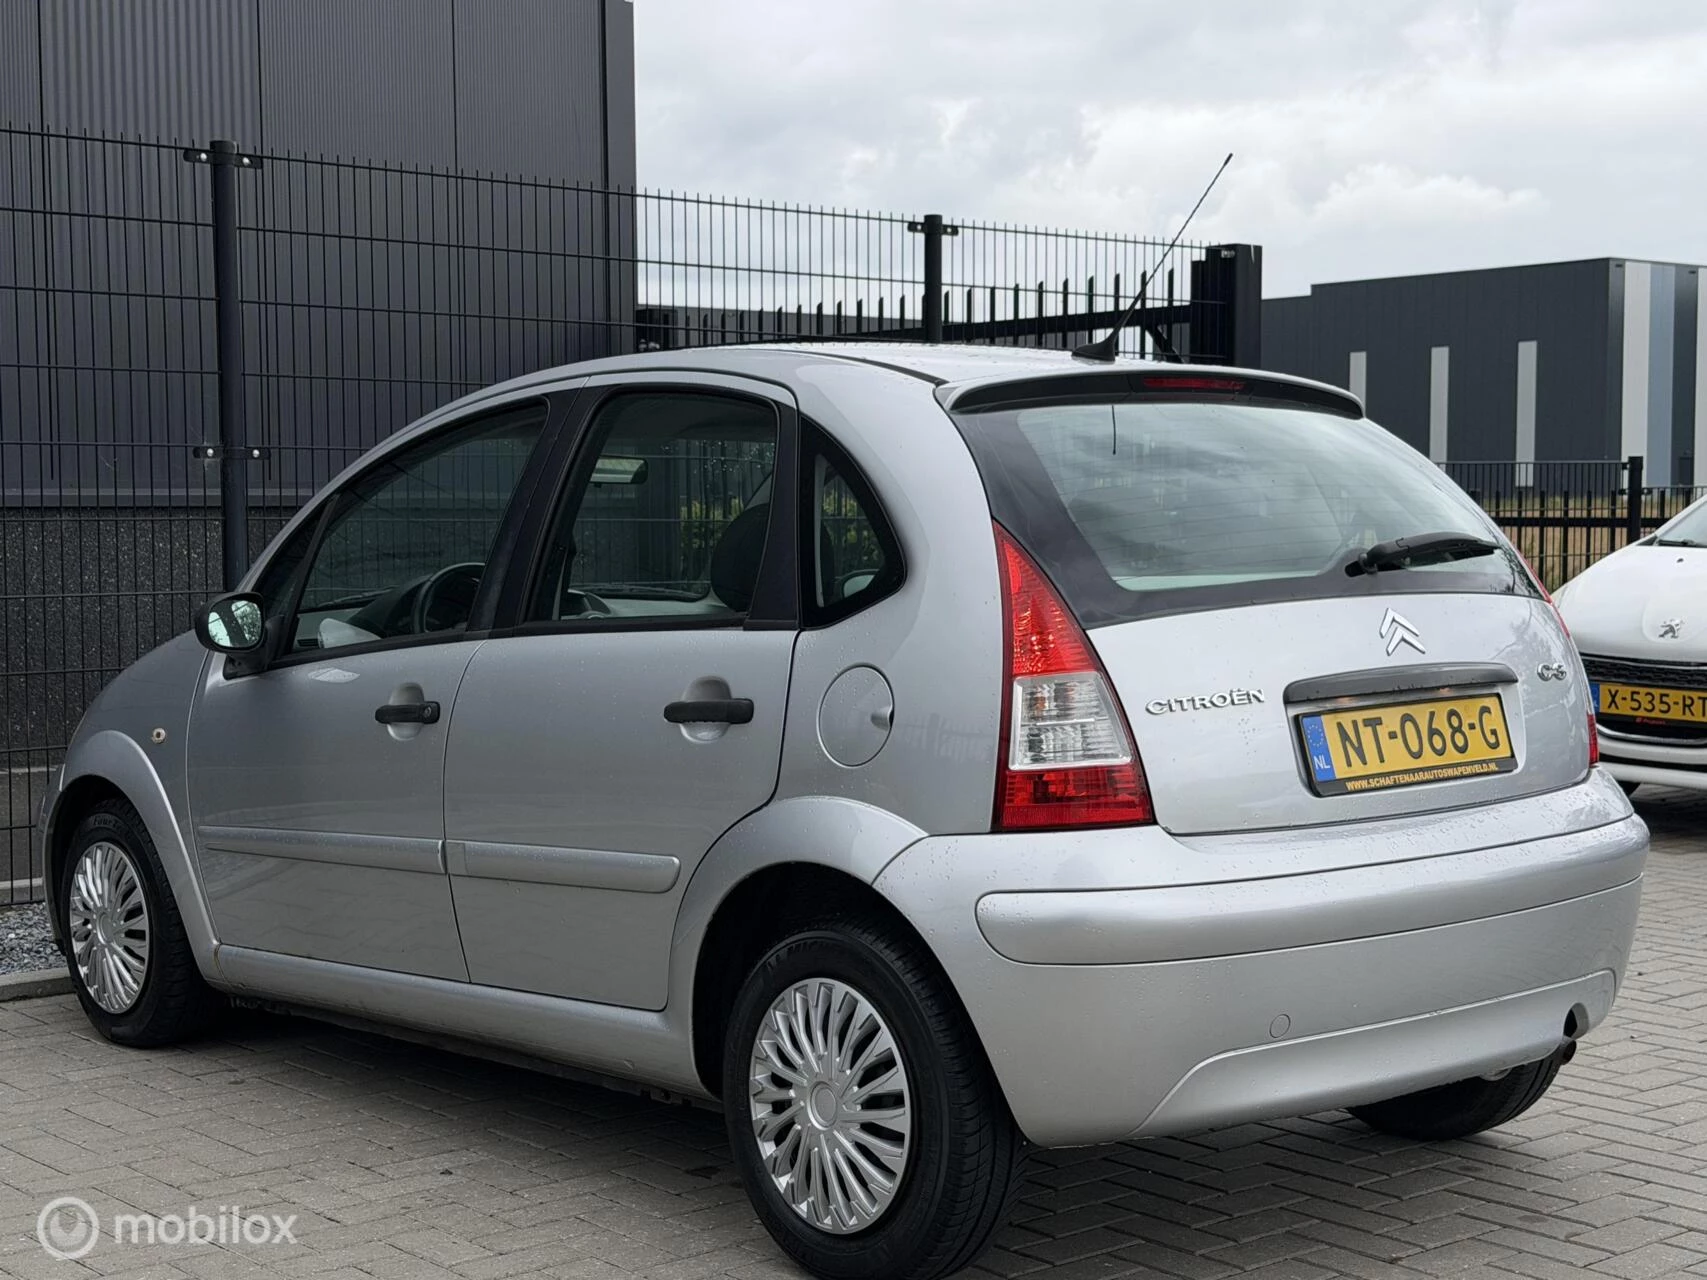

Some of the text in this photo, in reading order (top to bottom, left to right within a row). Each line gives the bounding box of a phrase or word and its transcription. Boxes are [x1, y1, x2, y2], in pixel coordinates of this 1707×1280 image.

[1145, 688, 1265, 715] CITROËN
[1607, 688, 1707, 718] X-535-RT
[1336, 705, 1501, 768] NT-068-G
[1313, 754, 1331, 770] NL
